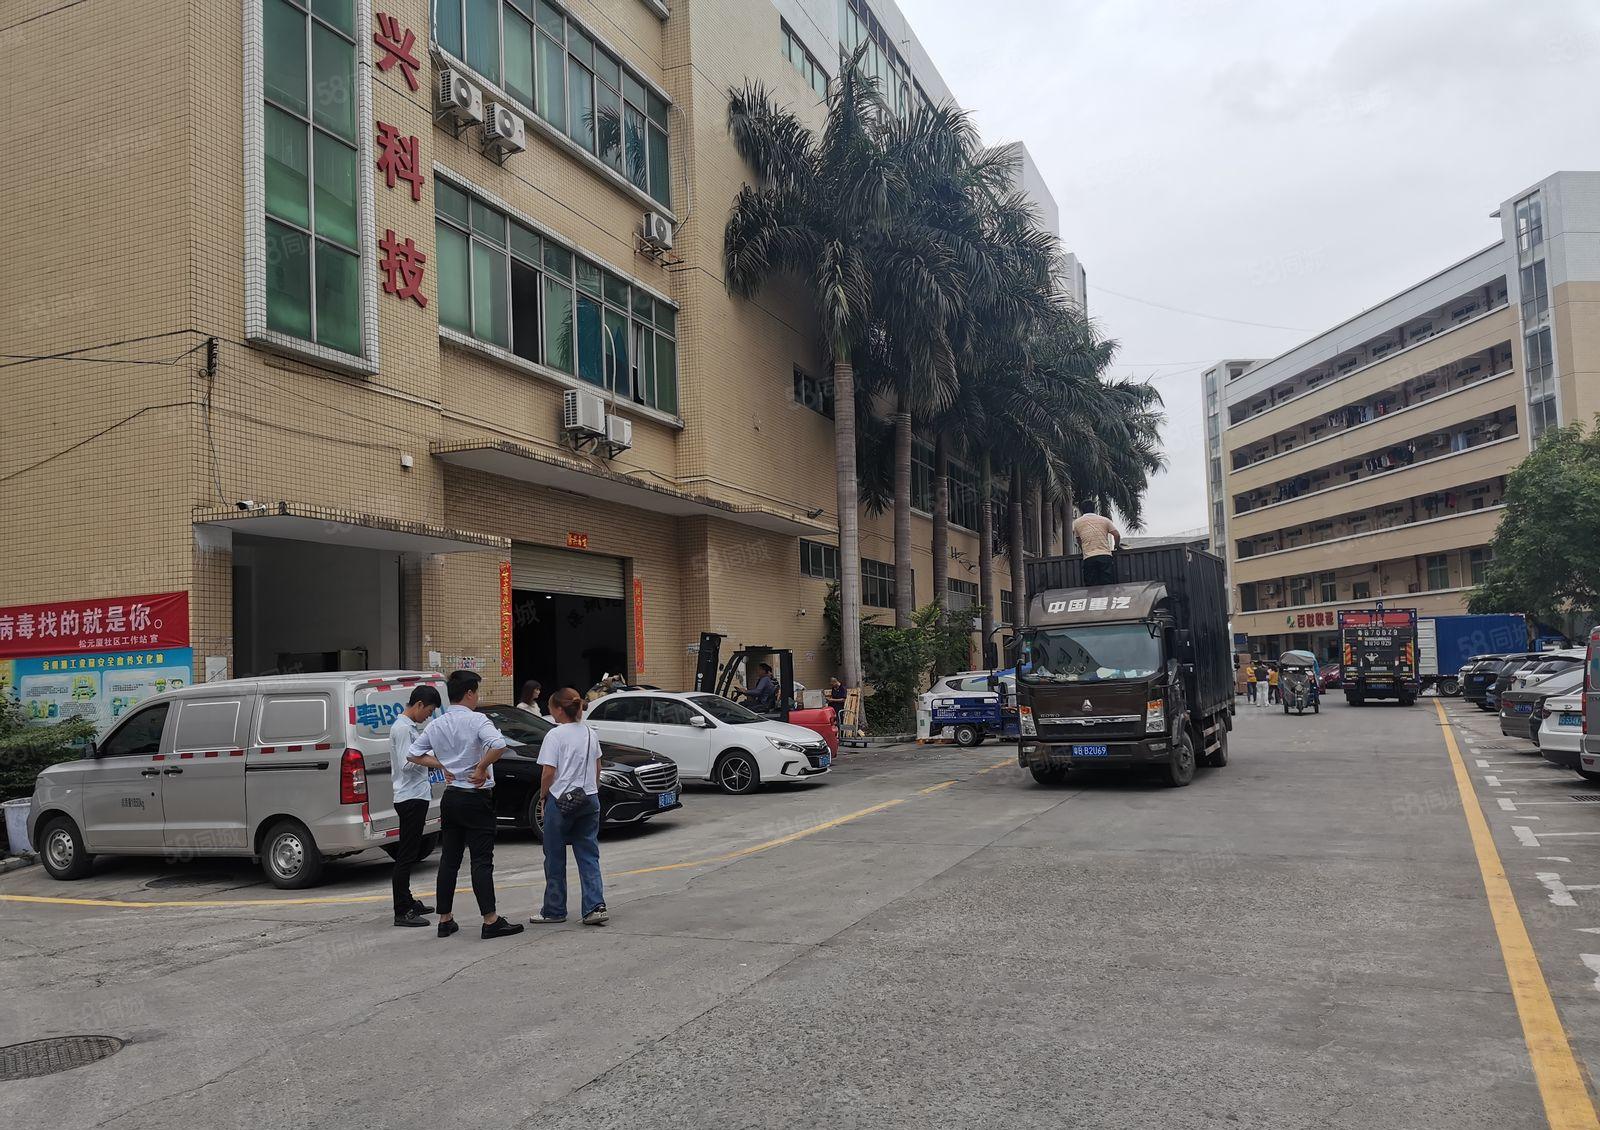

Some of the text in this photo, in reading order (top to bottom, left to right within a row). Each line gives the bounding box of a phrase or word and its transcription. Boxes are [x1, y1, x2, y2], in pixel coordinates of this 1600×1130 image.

[374, 12, 428, 309] 兴科技
[1048, 596, 1132, 614] 中国重汽
